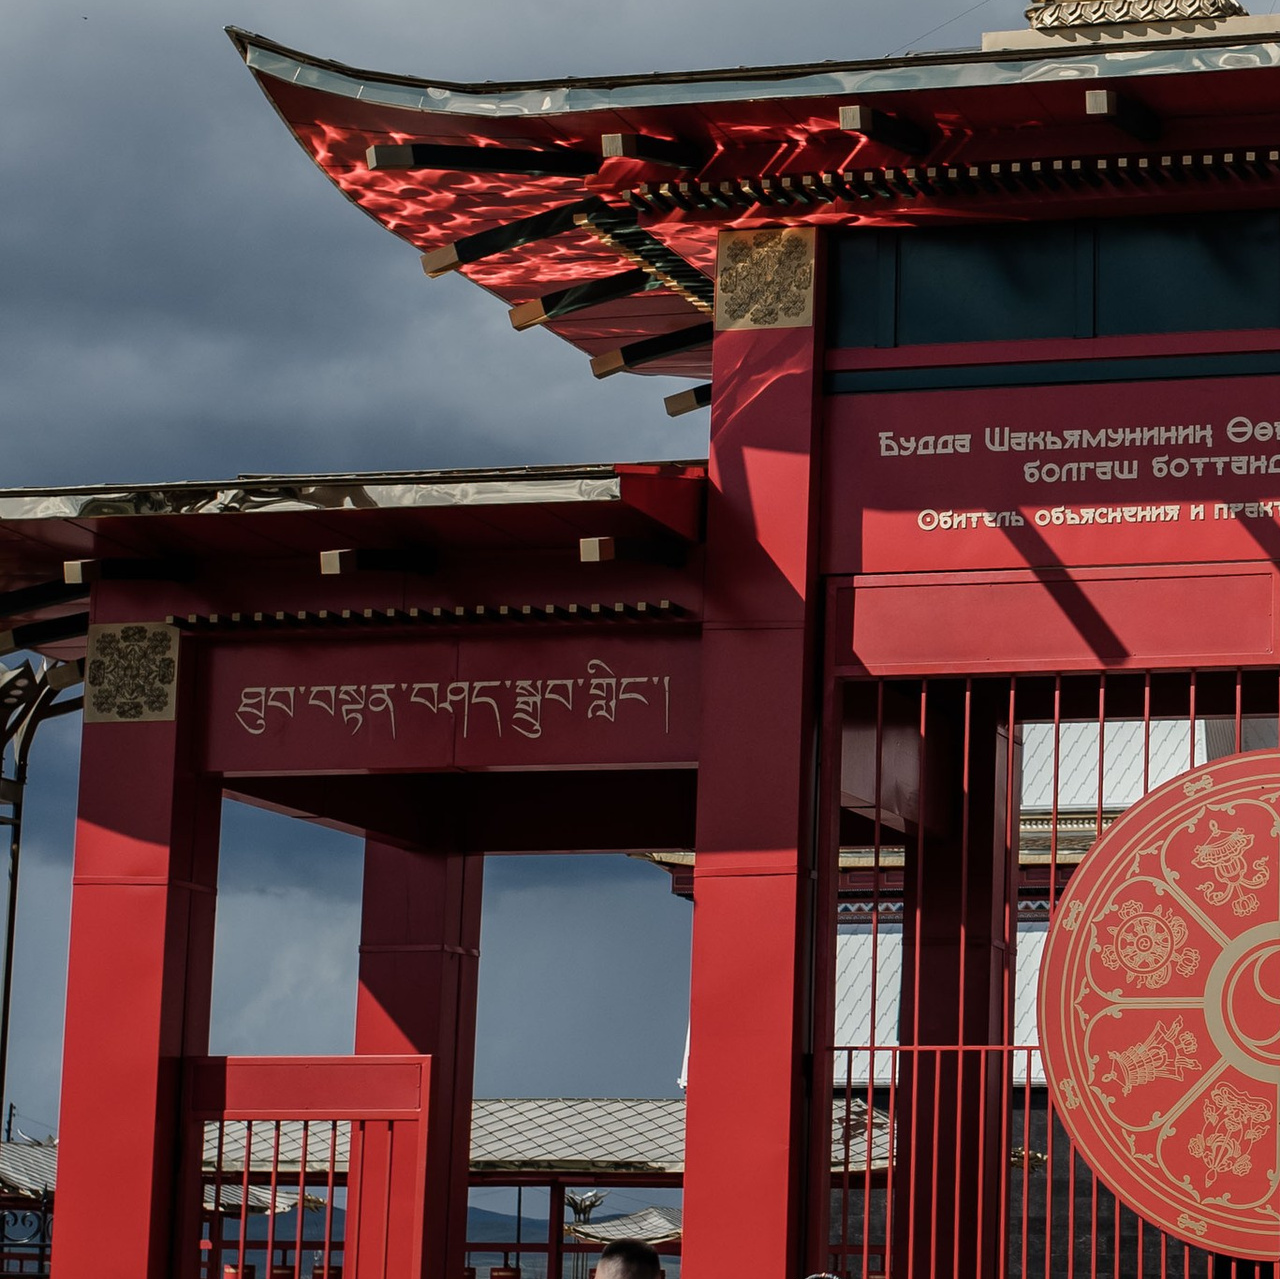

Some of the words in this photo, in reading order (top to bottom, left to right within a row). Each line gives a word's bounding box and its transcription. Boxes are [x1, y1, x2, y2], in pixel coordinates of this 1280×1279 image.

[878, 431, 972, 457] Будда
[1023, 459, 1138, 483] болгаш
[917, 508, 1025, 531] Обитель
[1034, 504, 1181, 527] объяснения
[1190, 504, 1205, 521] и
